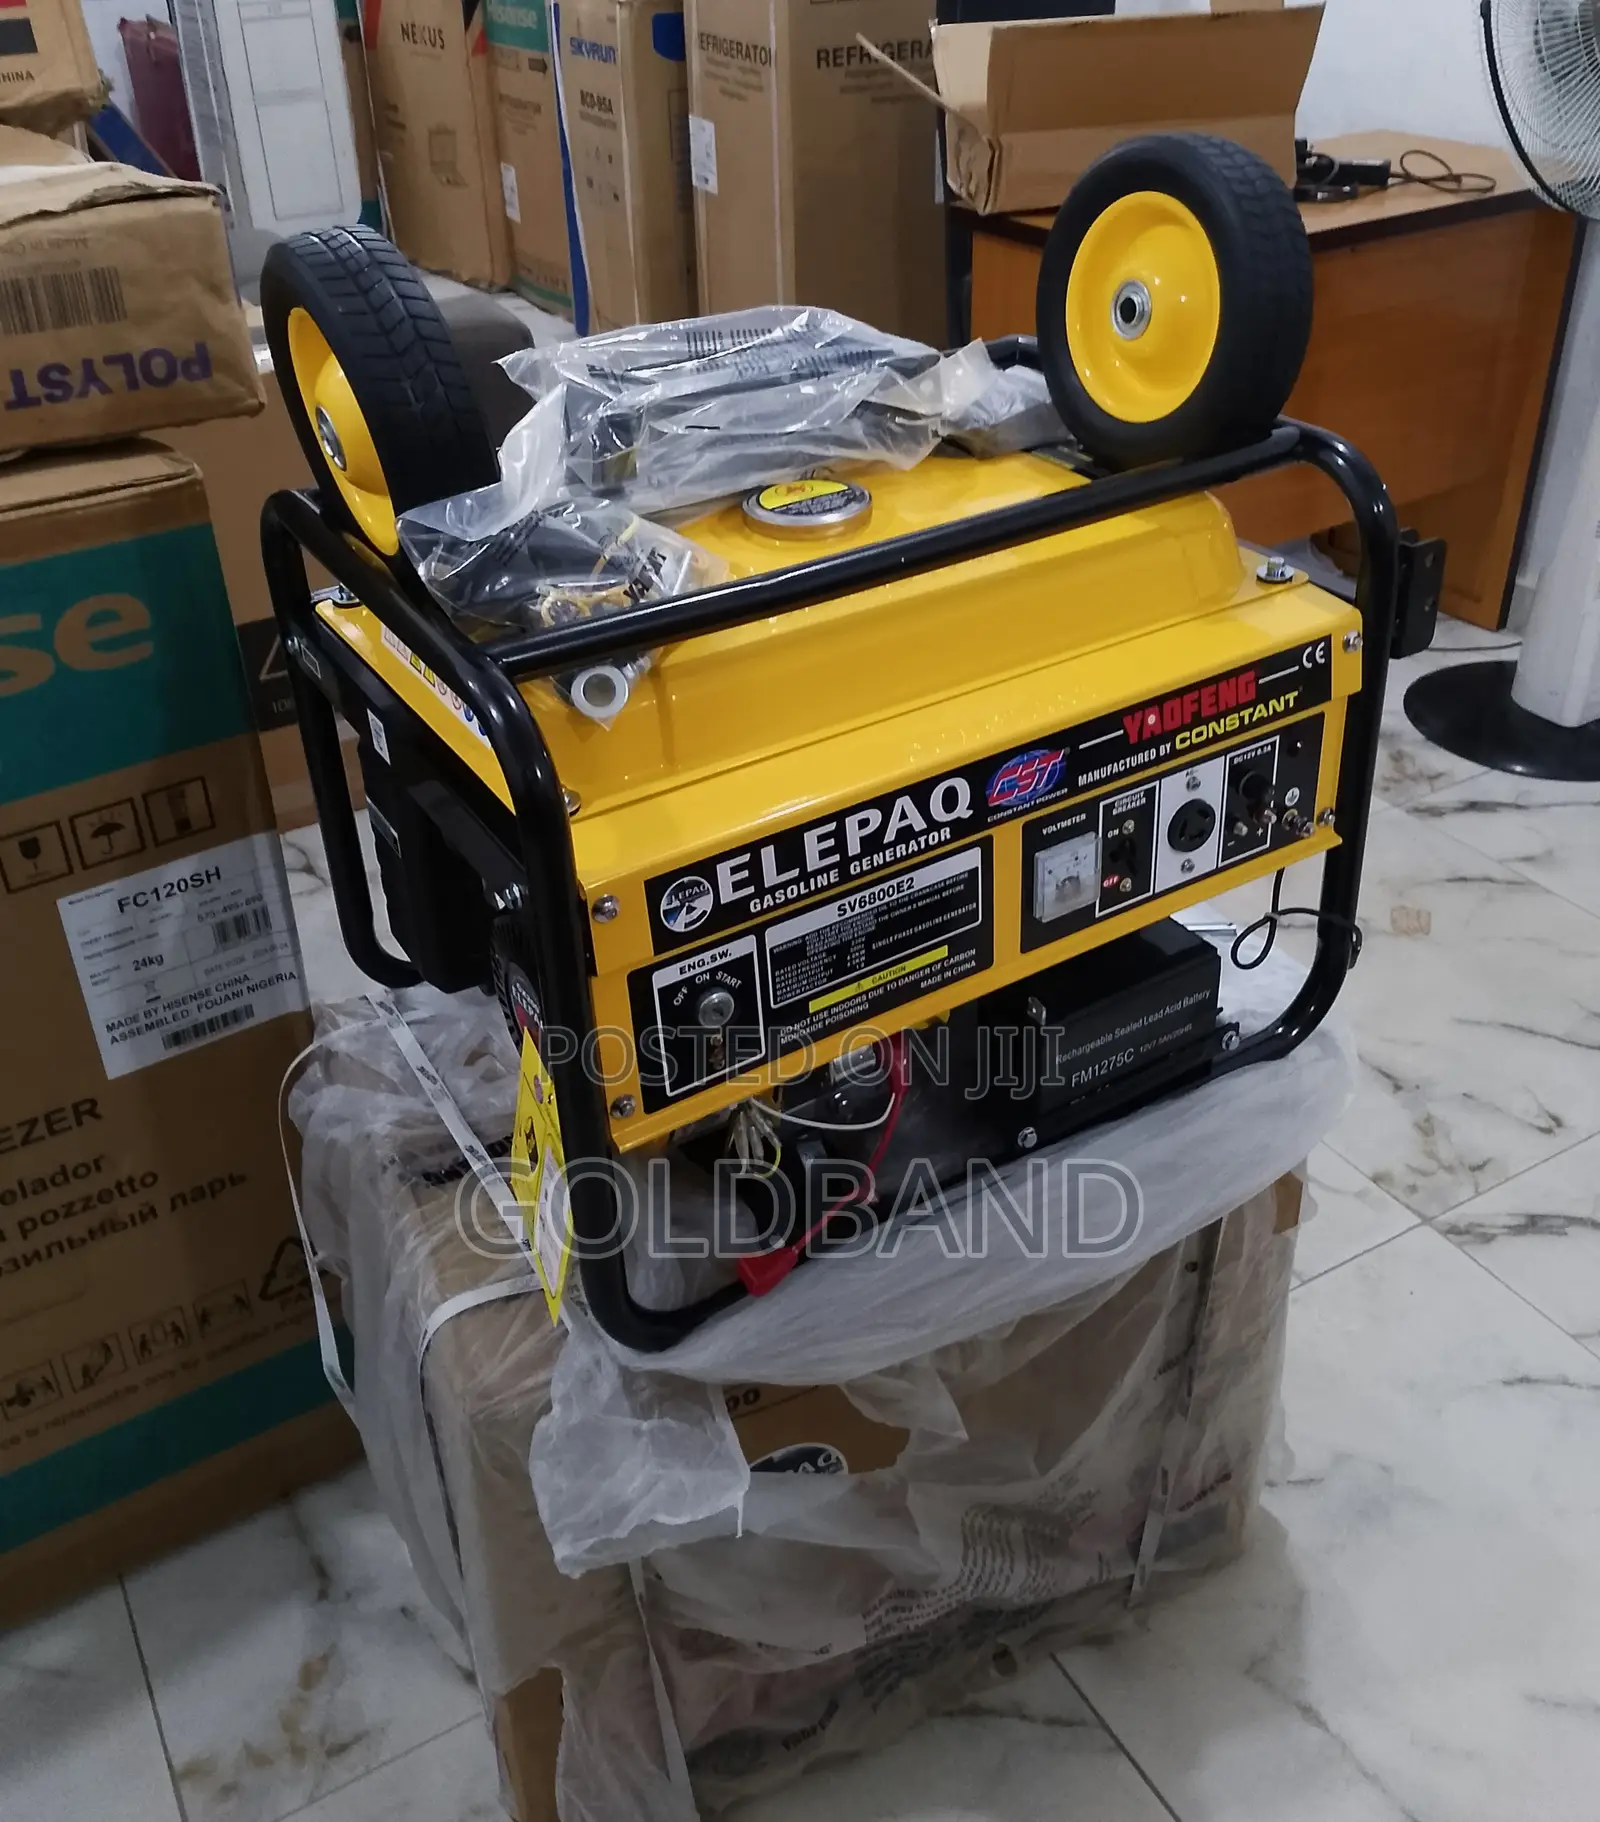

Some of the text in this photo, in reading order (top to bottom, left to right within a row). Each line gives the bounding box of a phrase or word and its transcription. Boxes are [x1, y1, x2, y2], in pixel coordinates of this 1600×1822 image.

[400, 23, 445, 50] NEXUS
[698, 32, 773, 69] EFRIGERATO
[4, 341, 213, 411] POLYST
[1123, 670, 1257, 745] YAOFENG
[1078, 690, 1299, 787] MANUFACTURED BY CONSTANT
[988, 787, 1068, 823] CONSTANT POWER
[1112, 797, 1146, 816] BREAKER
[1114, 791, 1145, 808] CIRCUIT
[715, 777, 974, 905] ELEPAQ
[1042, 813, 1087, 836] VOLTMETER
[1107, 827, 1119, 839] ON
[750, 827, 951, 914] GASOLINE GENERATOR
[1103, 875, 1119, 888] OFF
[118, 866, 221, 914] FC120SH
[836, 876, 915, 918] SV6800E2
[914, 915, 942, 933] GASOLINE
[943, 901, 976, 921] GENERATOR
[132, 953, 164, 973] 24kg
[679, 948, 732, 976] ENG.SW.
[871, 963, 906, 985] CAUTION
[920, 958, 975, 989] MADE IN CHINA
[673, 970, 742, 1006] OFF ON START
[812, 1009, 828, 1023] USE
[830, 993, 866, 1015] INDOORS
[868, 986, 884, 999] DUE
[886, 981, 895, 991] TO
[898, 967, 929, 987] DANGER
[931, 961, 941, 972] OF
[943, 947, 975, 968] CARBON
[105, 1013, 140, 1034] MADE
[143, 1006, 160, 1021] BY
[162, 986, 213, 1014] HISENSE
[825, 1001, 868, 1026] POISONING
[1056, 989, 1211, 1065] Rechargeable Sealed Lead Acid Battery
[1071, 1048, 1135, 1088] FM1275C
[17, 1169, 160, 1241] pozzetto
[0, 1204, 160, 1278] зильный
